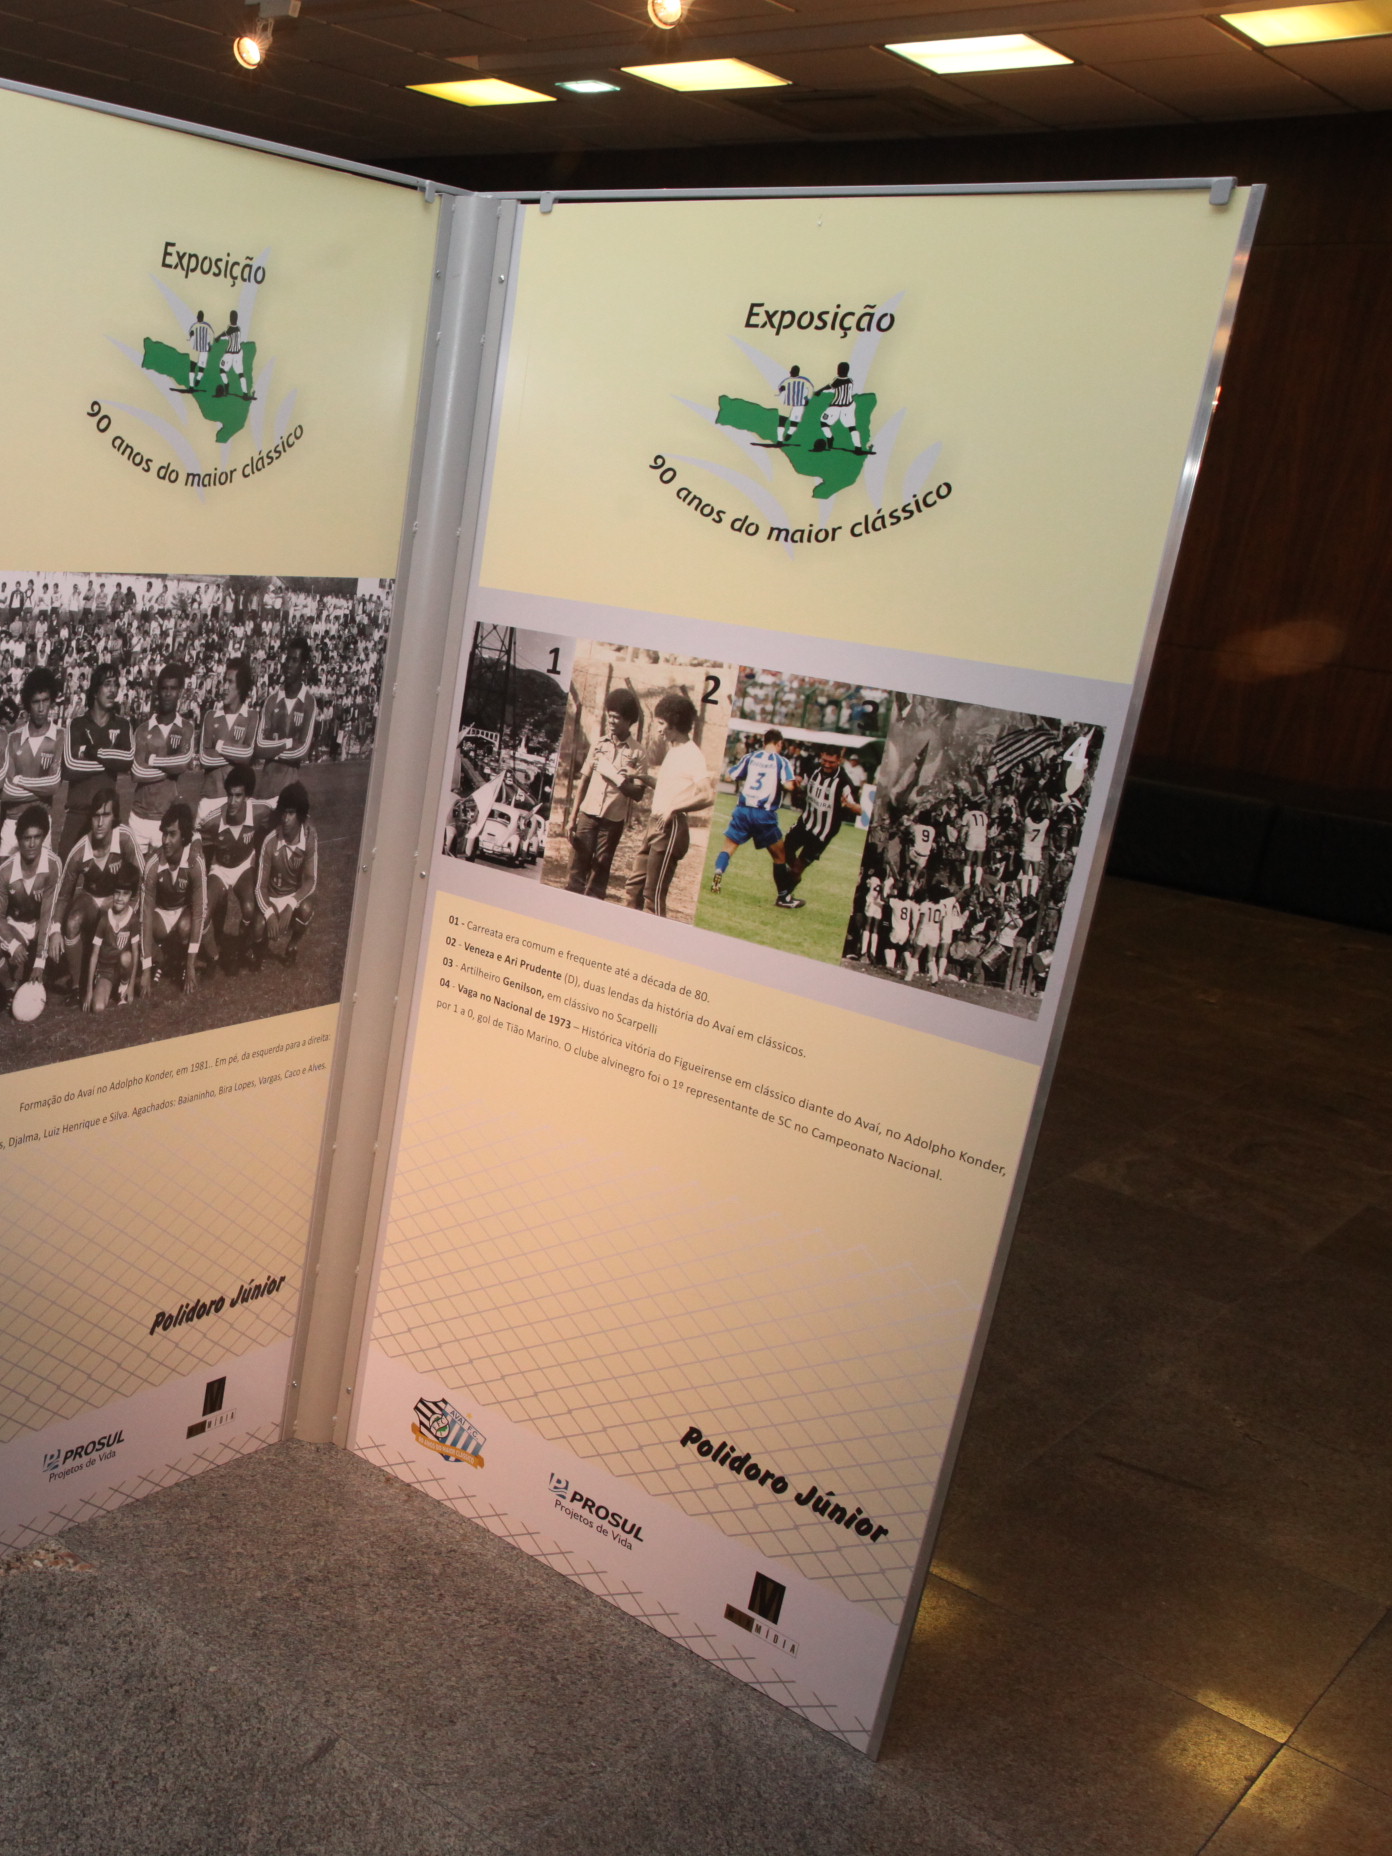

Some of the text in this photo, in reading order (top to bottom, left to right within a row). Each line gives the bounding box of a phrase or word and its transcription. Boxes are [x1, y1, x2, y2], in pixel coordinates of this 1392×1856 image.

[161, 241, 266, 287] Exposição
[744, 302, 896, 339] Exposição
[86, 400, 304, 488] 90 anos do maior clássico
[648, 454, 953, 544] 90 anos do maior clássico
[546, 647, 561, 675] 1
[701, 675, 721, 705] 2
[750, 772, 767, 790] 3
[921, 829, 930, 843] 9
[971, 814, 985, 827] 11
[1031, 829, 1040, 842] 7
[900, 906, 908, 920] 8
[448, 915, 710, 1003] 01 Carreata era comum frequente até década 80.
[442, 957, 658, 1035] 03 Artilheiro Genilson, clássivo Scarpelli
[445, 936, 807, 1059] 02 Veneza Ari Prudente (D), duas lendas história Avaí clássicos.
[19, 1094, 62, 1113] Formação
[76, 1086, 96, 1100] Avaí
[109, 1073, 144, 1092] Adolpho
[145, 1069, 175, 1084] Konder,
[251, 1043, 284, 1060] esquerda
[284, 1040, 301, 1054] para
[307, 1032, 332, 1046] direita:
[436, 999, 452, 1011] por
[477, 1011, 491, 1027] gol
[505, 1021, 525, 1036] Tião
[526, 1029, 561, 1050] Marino.
[573, 1045, 599, 1062] clube
[600, 1056, 646, 1080] alvinegro
[647, 1071, 661, 1083] foi
[685, 1085, 759, 1118] representante
[777, 1115, 792, 1129] SC
[811, 1127, 885, 1161] Campeonato
[887, 1152, 943, 1181] Nacional.
[439, 977, 1007, 1177] 04 Vaga Nacional 1973 Histórica vitória Figueirense clássico diante Avaí, Adolpho Konder,
[8, 1130, 41, 1149] Djalma,
[43, 1126, 61, 1139] Luiz
[61, 1117, 101, 1135] Henrique
[109, 1110, 130, 1122] Silva.
[131, 1098, 176, 1118] Agachados:
[177, 1088, 217, 1106] Baianinho,
[218, 1084, 233, 1095] Bira
[234, 1079, 257, 1093] Lopes,
[258, 1073, 283, 1087] Vargas,
[283, 1068, 302, 1080] Caco
[307, 1061, 327, 1073] Alves.
[149, 1275, 286, 1335] Polidoro Júnior
[48, 1449, 117, 1482] Projetos Vida
[62, 1430, 125, 1465] PROSUL
[680, 1426, 889, 1543] Polidoro Júnior
[554, 1499, 633, 1551] Projetos Vida
[569, 1490, 644, 1543] PROSUL
